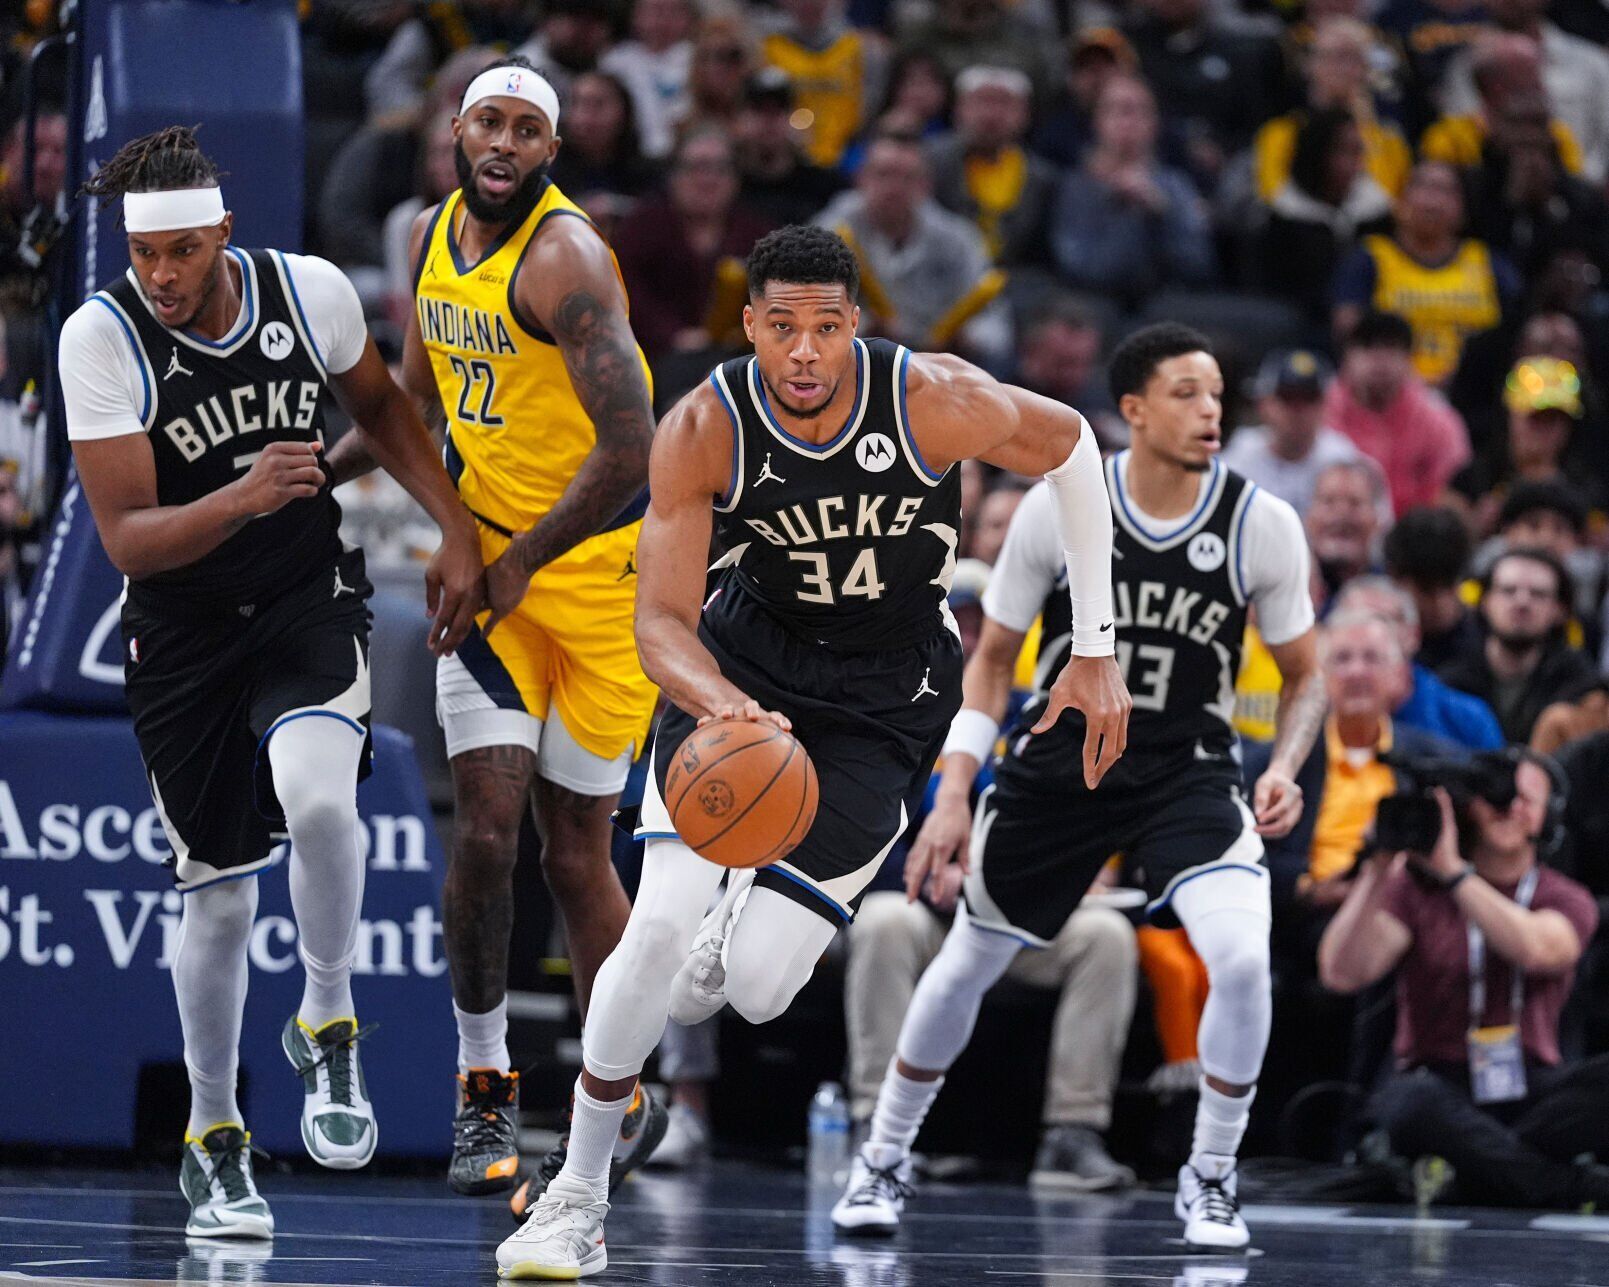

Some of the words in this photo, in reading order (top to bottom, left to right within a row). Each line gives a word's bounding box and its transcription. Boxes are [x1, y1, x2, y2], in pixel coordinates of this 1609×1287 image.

[418, 296, 518, 354] INDIANA
[164, 380, 320, 463] BUCKS
[448, 354, 505, 427] 22
[743, 494, 925, 546] BUCKS
[788, 547, 887, 605] 34
[1112, 581, 1230, 645] UCKS
[82, 888, 449, 978] Vicnt
